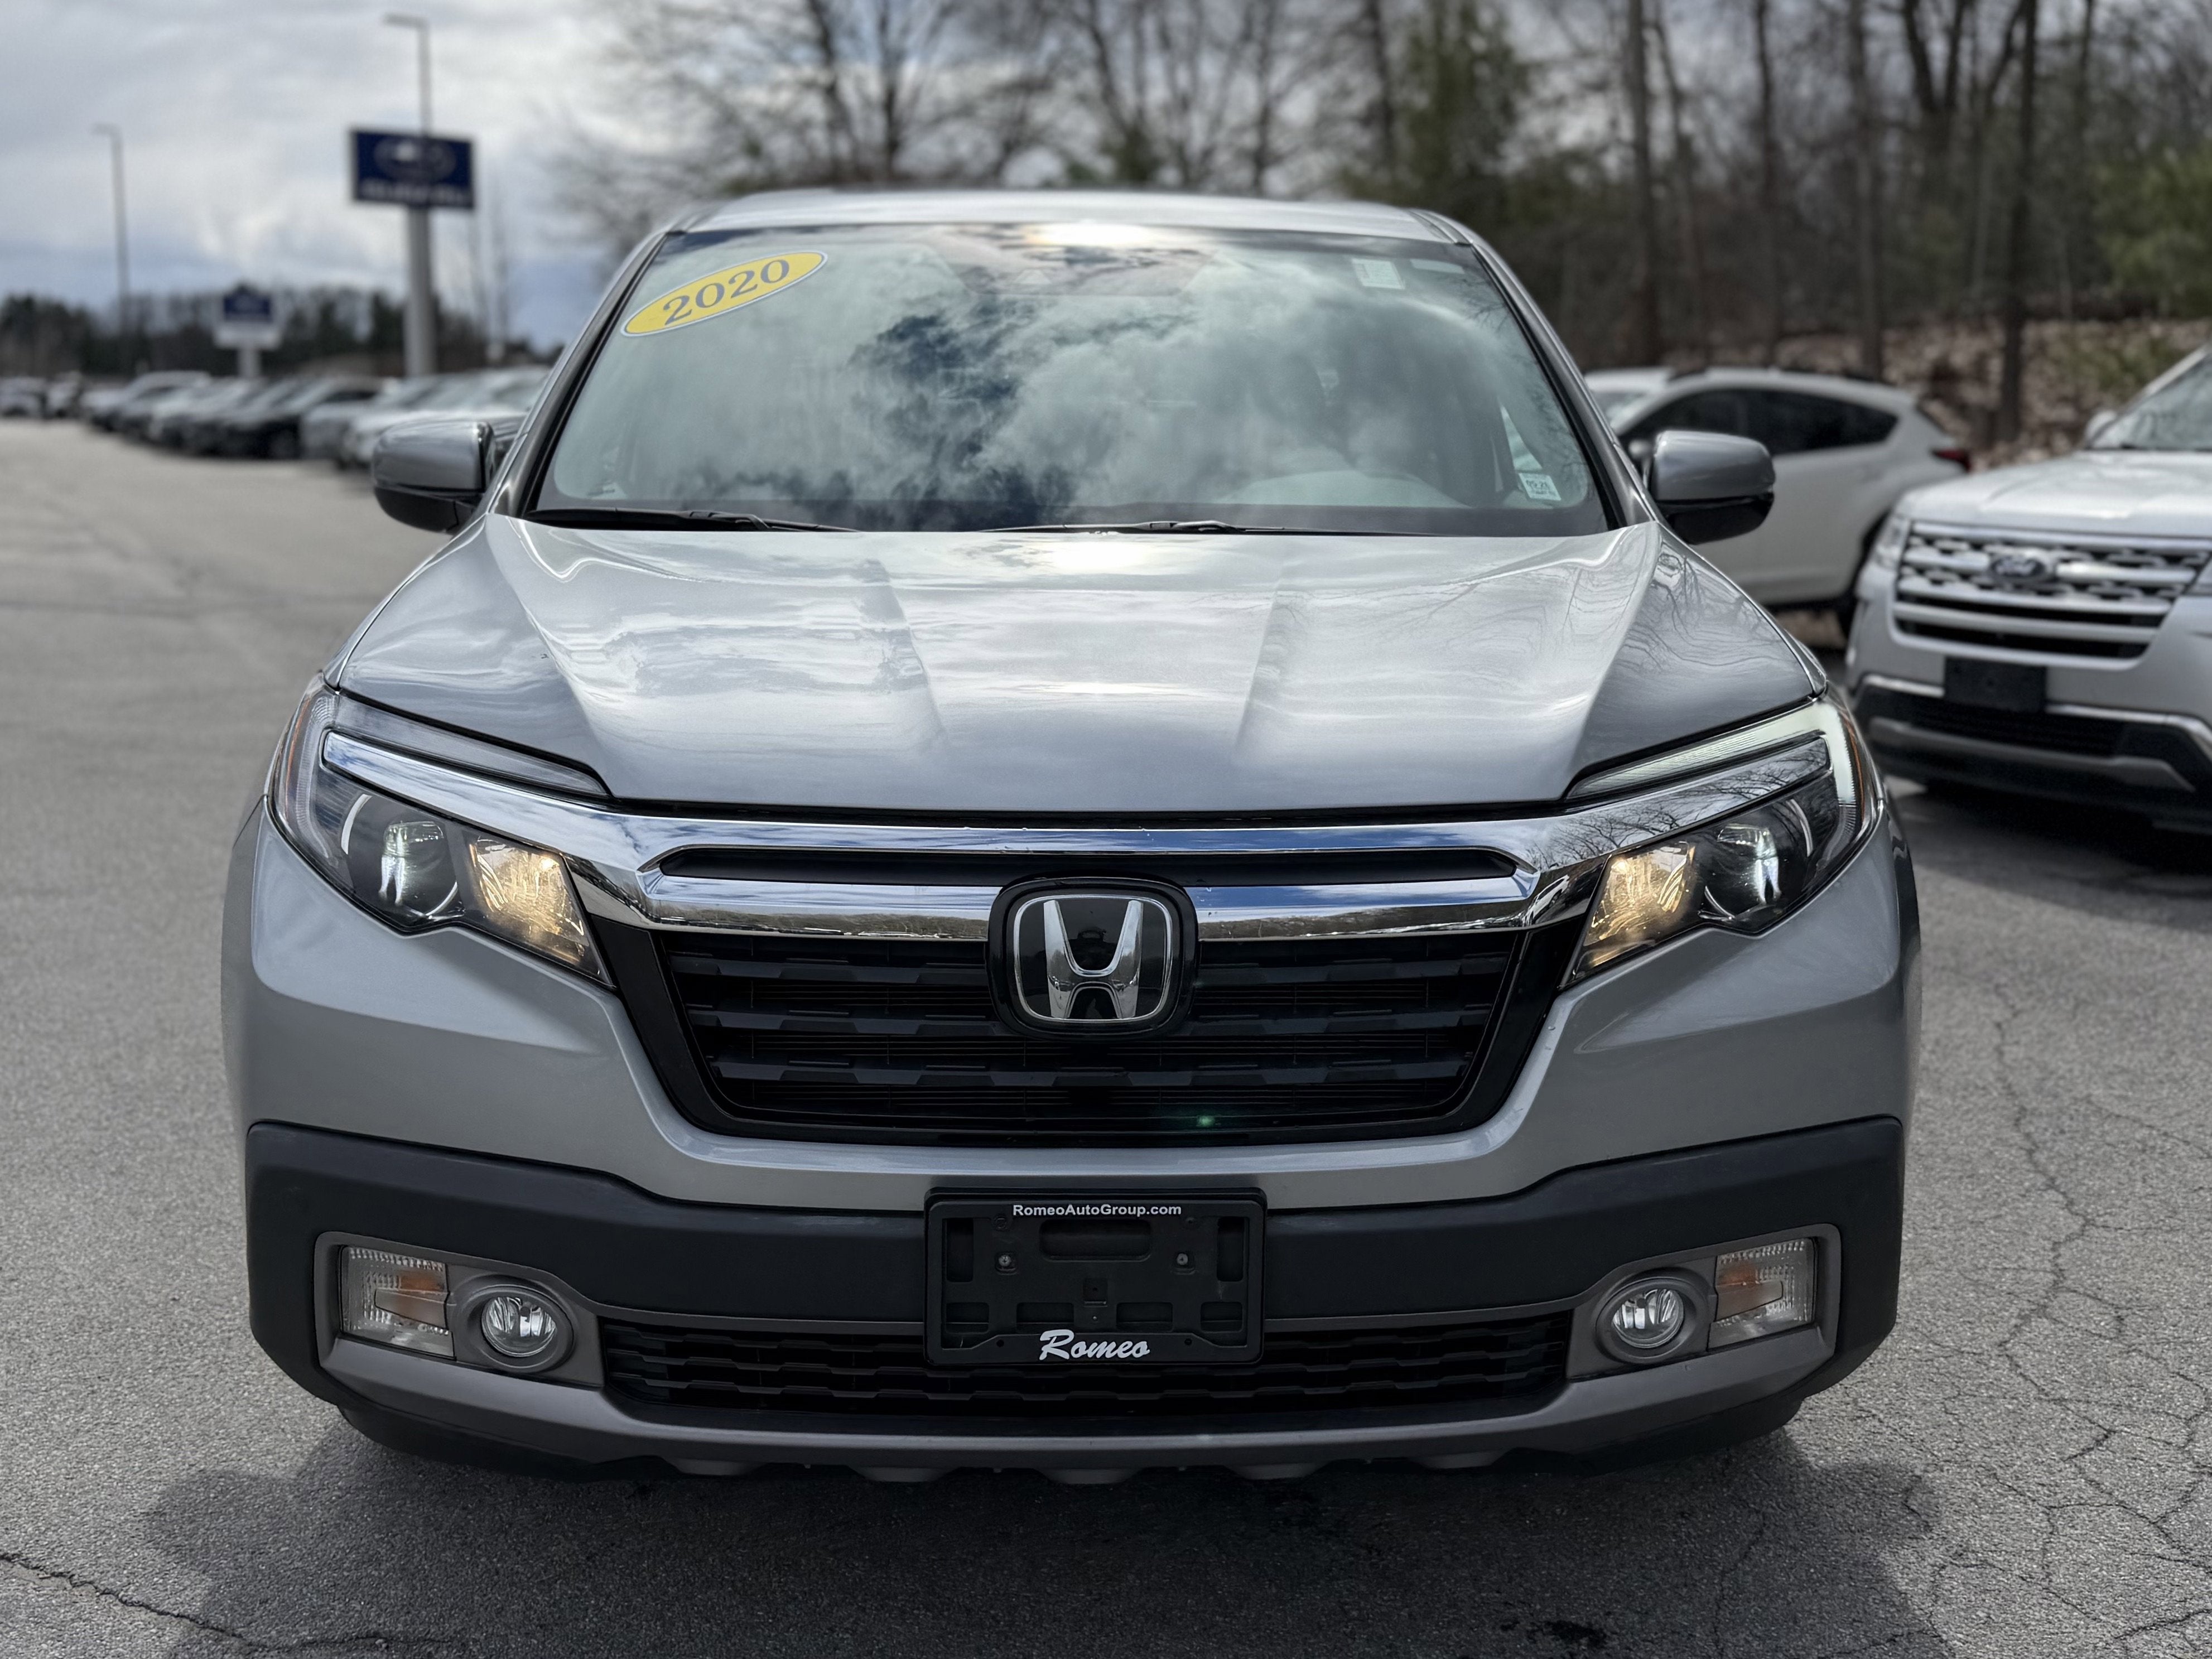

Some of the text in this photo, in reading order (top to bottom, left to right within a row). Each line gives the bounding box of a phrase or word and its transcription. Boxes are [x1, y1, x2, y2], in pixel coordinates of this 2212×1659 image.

[663, 259, 790, 326] 2020
[1013, 1203, 1182, 1217] RomeoAutoGroup.com
[1039, 1329, 1151, 1361] Romeo
